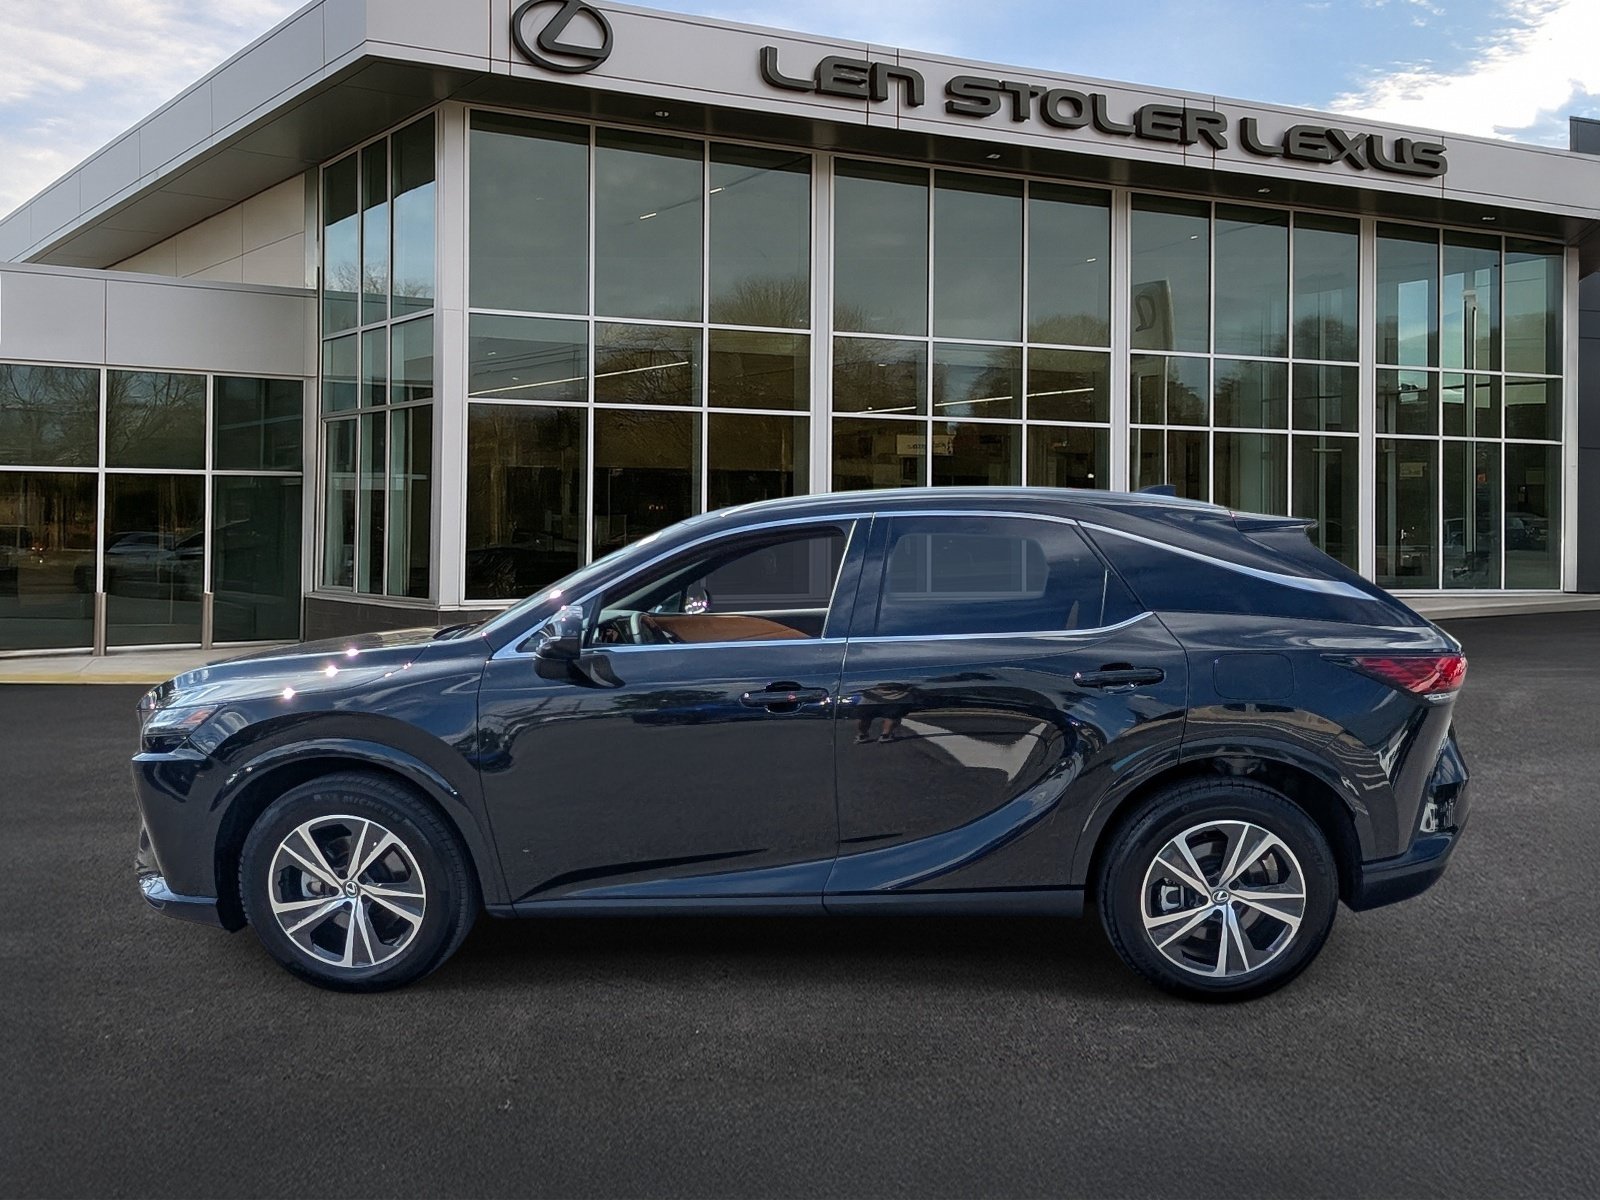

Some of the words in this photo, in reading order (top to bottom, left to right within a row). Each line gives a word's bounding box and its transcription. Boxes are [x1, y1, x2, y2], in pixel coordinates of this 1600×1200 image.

[760, 46, 925, 108] LEN
[945, 75, 1228, 150] STOLER
[1240, 117, 1448, 178] LEXUS
